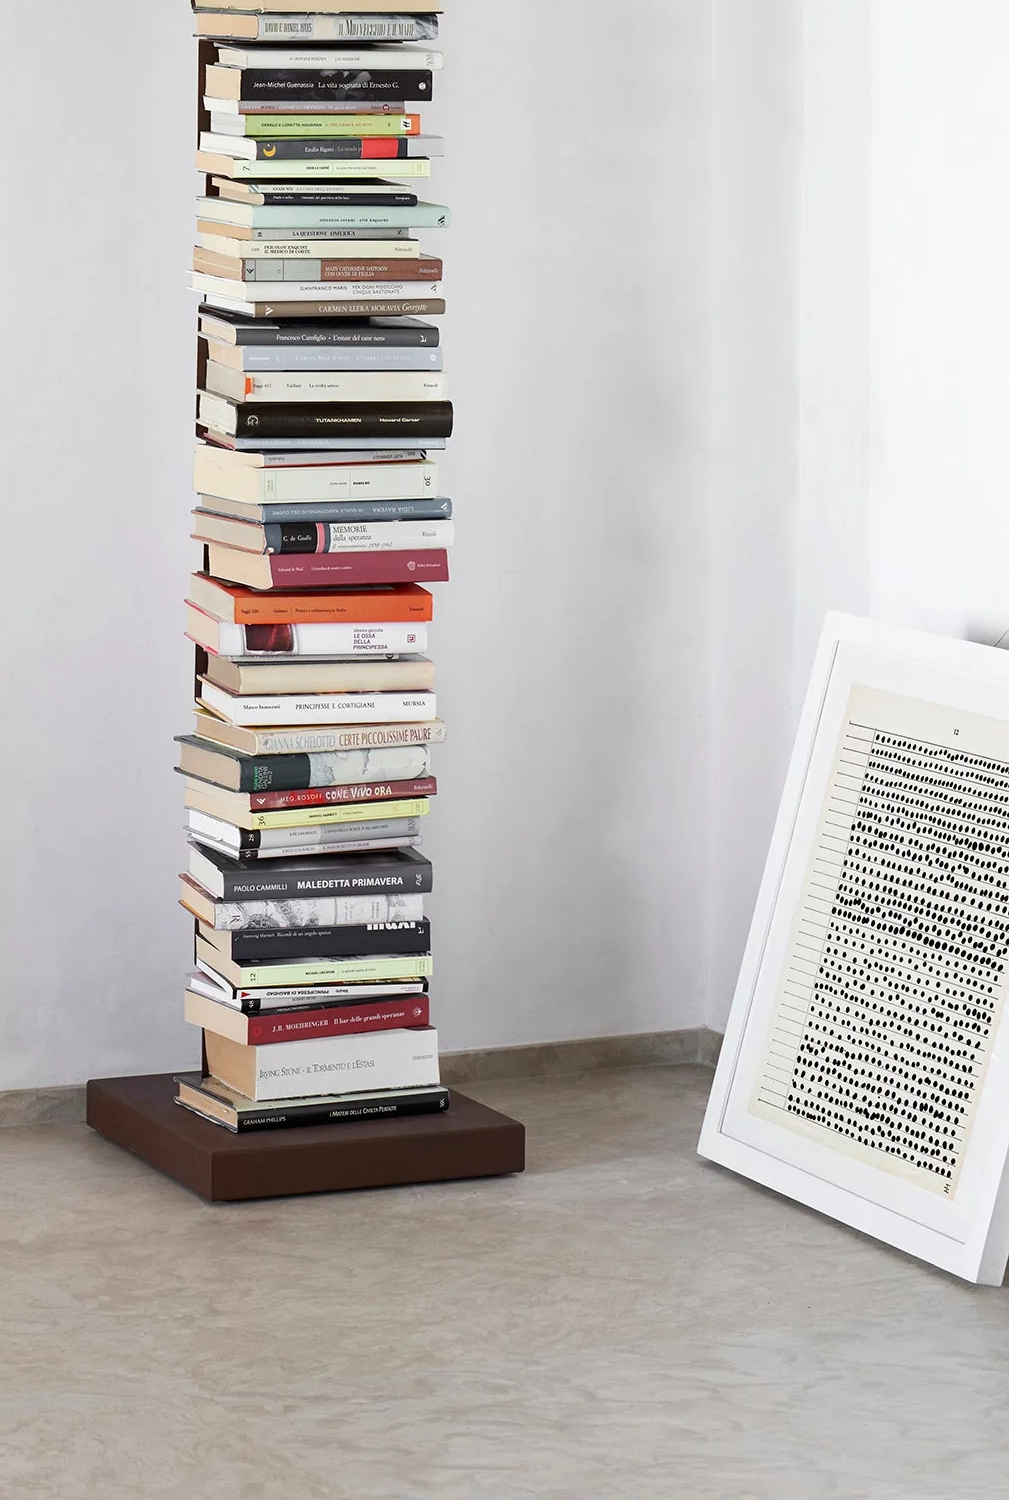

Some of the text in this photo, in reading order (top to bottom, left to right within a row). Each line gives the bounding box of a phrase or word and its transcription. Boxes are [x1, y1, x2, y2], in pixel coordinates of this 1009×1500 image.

[371, 304, 401, 312] MORAVIA
[402, 303, 428, 314] Georgette
[424, 476, 431, 487] 30
[339, 728, 432, 746] CERTE PICCOLISSIME PAURE
[280, 795, 294, 803] MEG
[325, 790, 348, 800] COME
[350, 788, 372, 797] VIVO
[374, 786, 392, 796] ORA
[258, 815, 266, 826] 36
[297, 876, 404, 890] MALEDETTA PRIMAVERA
[363, 1014, 380, 1023] grandi
[285, 1019, 329, 1031] MOEHRINGER
[259, 1067, 301, 1080] IRVING STONE
[312, 1063, 345, 1074] TORMENTO
[242, 1116, 286, 1126] GRAHAM PHILLIPS
